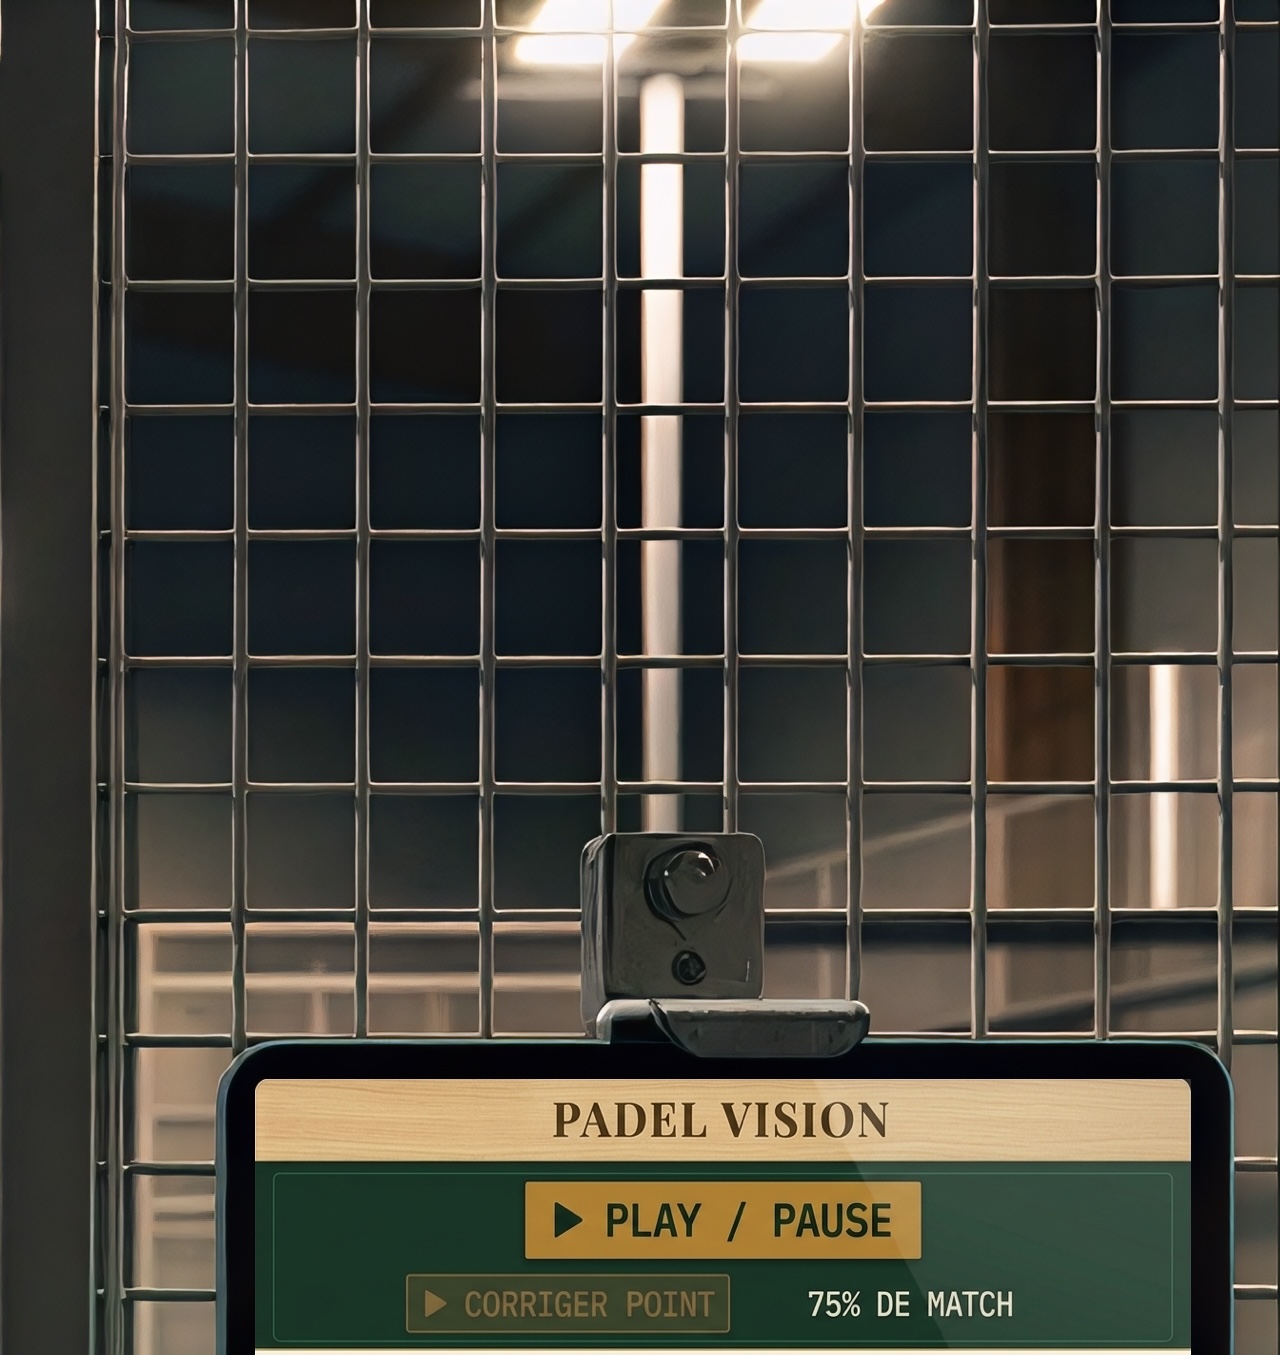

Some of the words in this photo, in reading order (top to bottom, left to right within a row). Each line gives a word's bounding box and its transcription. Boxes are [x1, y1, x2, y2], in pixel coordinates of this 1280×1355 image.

[553, 1103, 706, 1137] PADEL
[721, 1102, 888, 1138] VISION
[607, 1203, 702, 1237] PLAY
[727, 1202, 746, 1242] /
[774, 1202, 891, 1238] PAUSE
[465, 1291, 607, 1317] CORRIGER
[627, 1291, 715, 1317] POINT
[809, 1291, 860, 1317] 75%
[878, 1291, 909, 1316] DE
[928, 1291, 1012, 1317] MATCH
